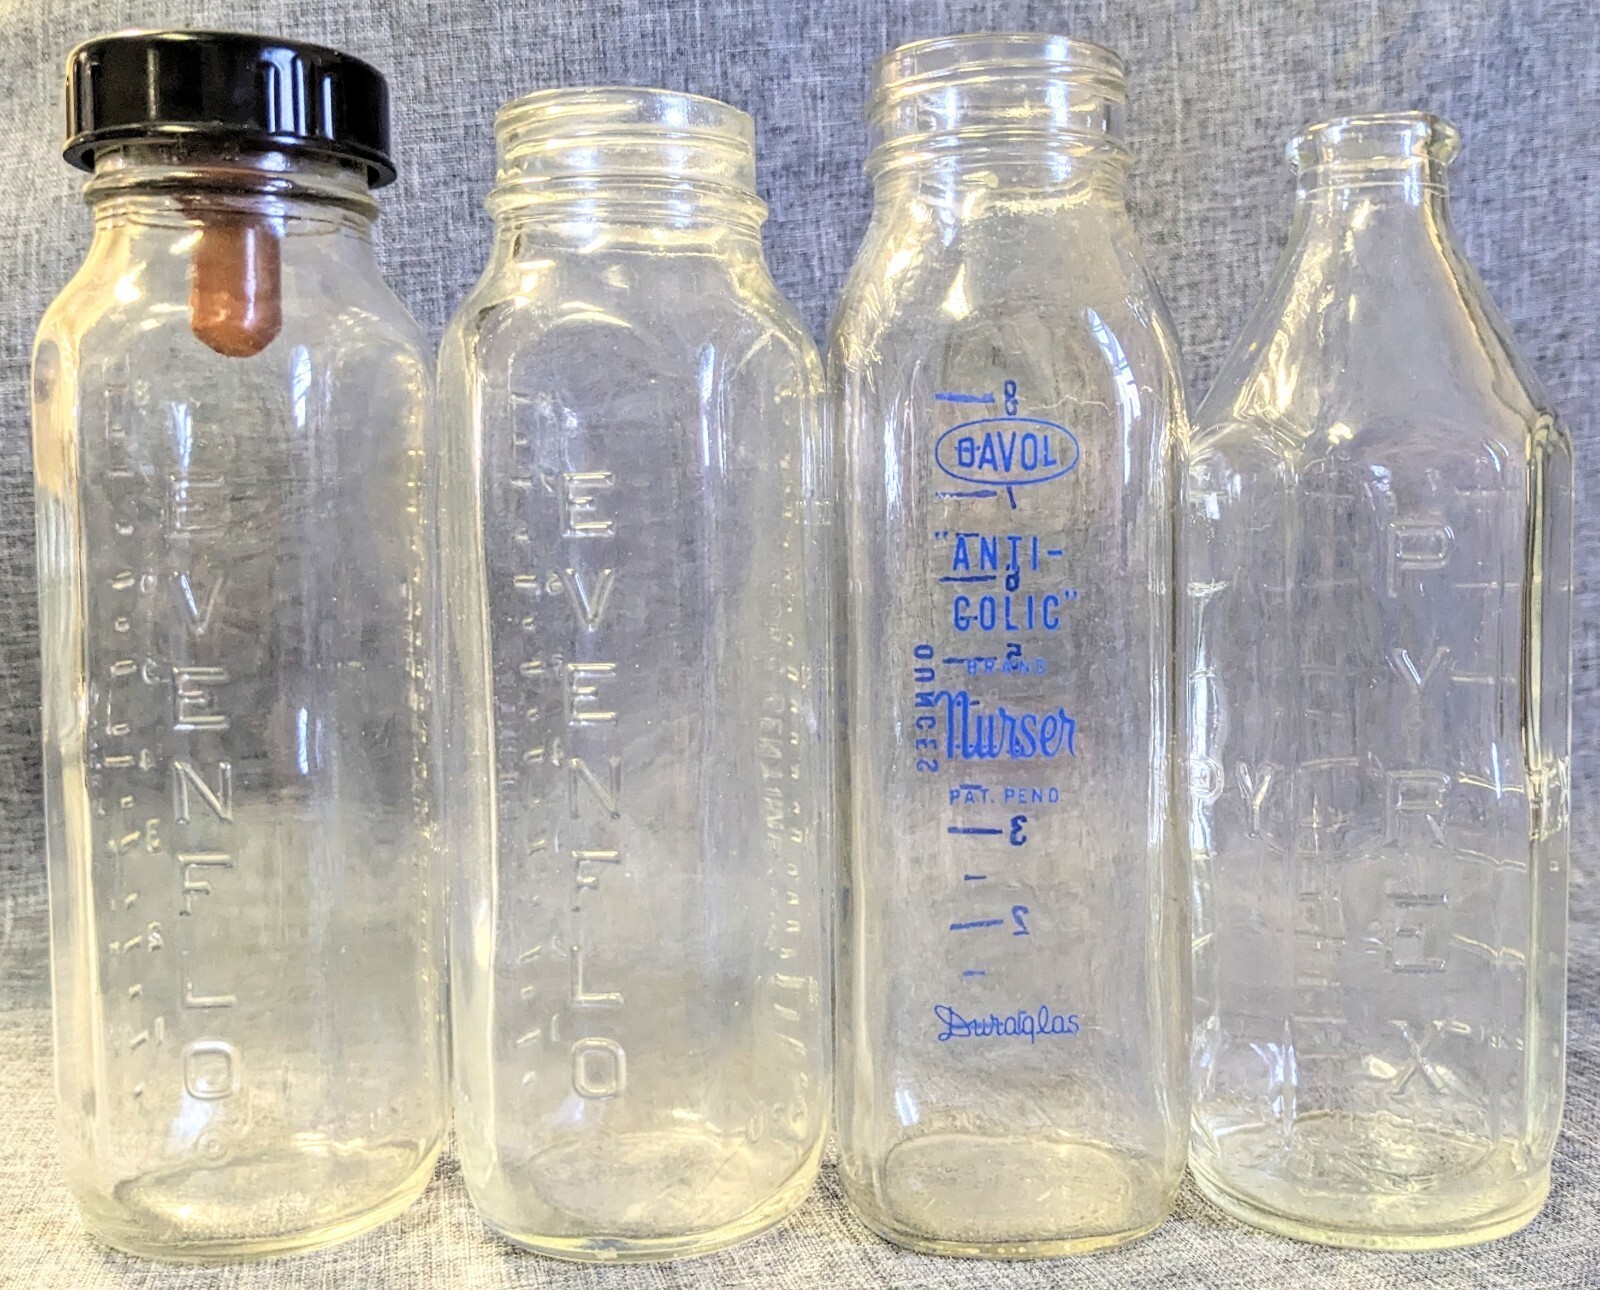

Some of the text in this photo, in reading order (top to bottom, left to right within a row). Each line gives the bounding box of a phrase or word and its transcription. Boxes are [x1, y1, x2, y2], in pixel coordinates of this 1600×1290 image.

[166, 474, 242, 1101] EVENFLO
[560, 470, 628, 1100] EVENFLO
[934, 689, 1077, 759] Nurser
[967, 657, 1049, 677] BRAND
[1384, 518, 1456, 1095] PYREX
